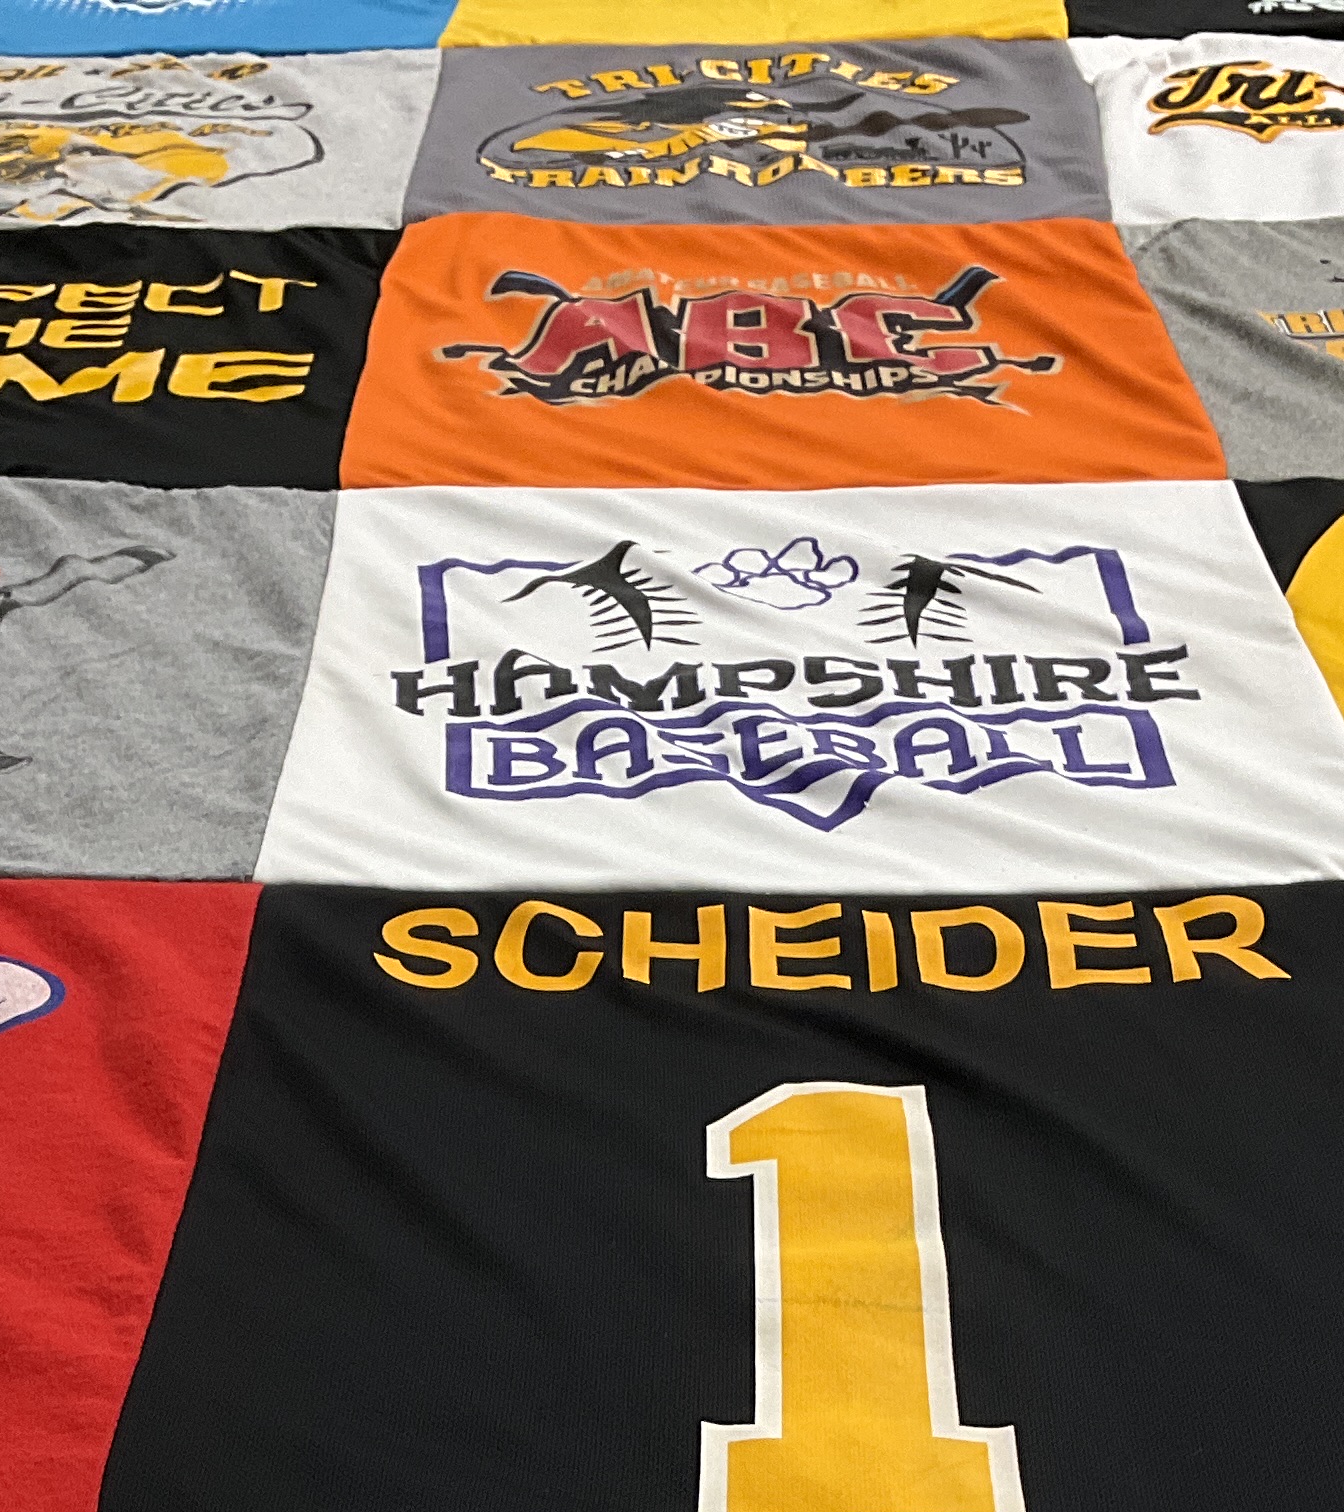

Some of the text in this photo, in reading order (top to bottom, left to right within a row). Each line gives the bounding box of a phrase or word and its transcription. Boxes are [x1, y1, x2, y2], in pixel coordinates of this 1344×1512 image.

[478, 155, 704, 188] TRAIN
[511, 286, 994, 374] ABC
[569, 353, 940, 395] CHAPIONSHIPS
[391, 645, 1201, 718] HAMPSHIRE
[486, 708, 1133, 787] BASEBALL
[373, 895, 1292, 992] SCHEIDER
